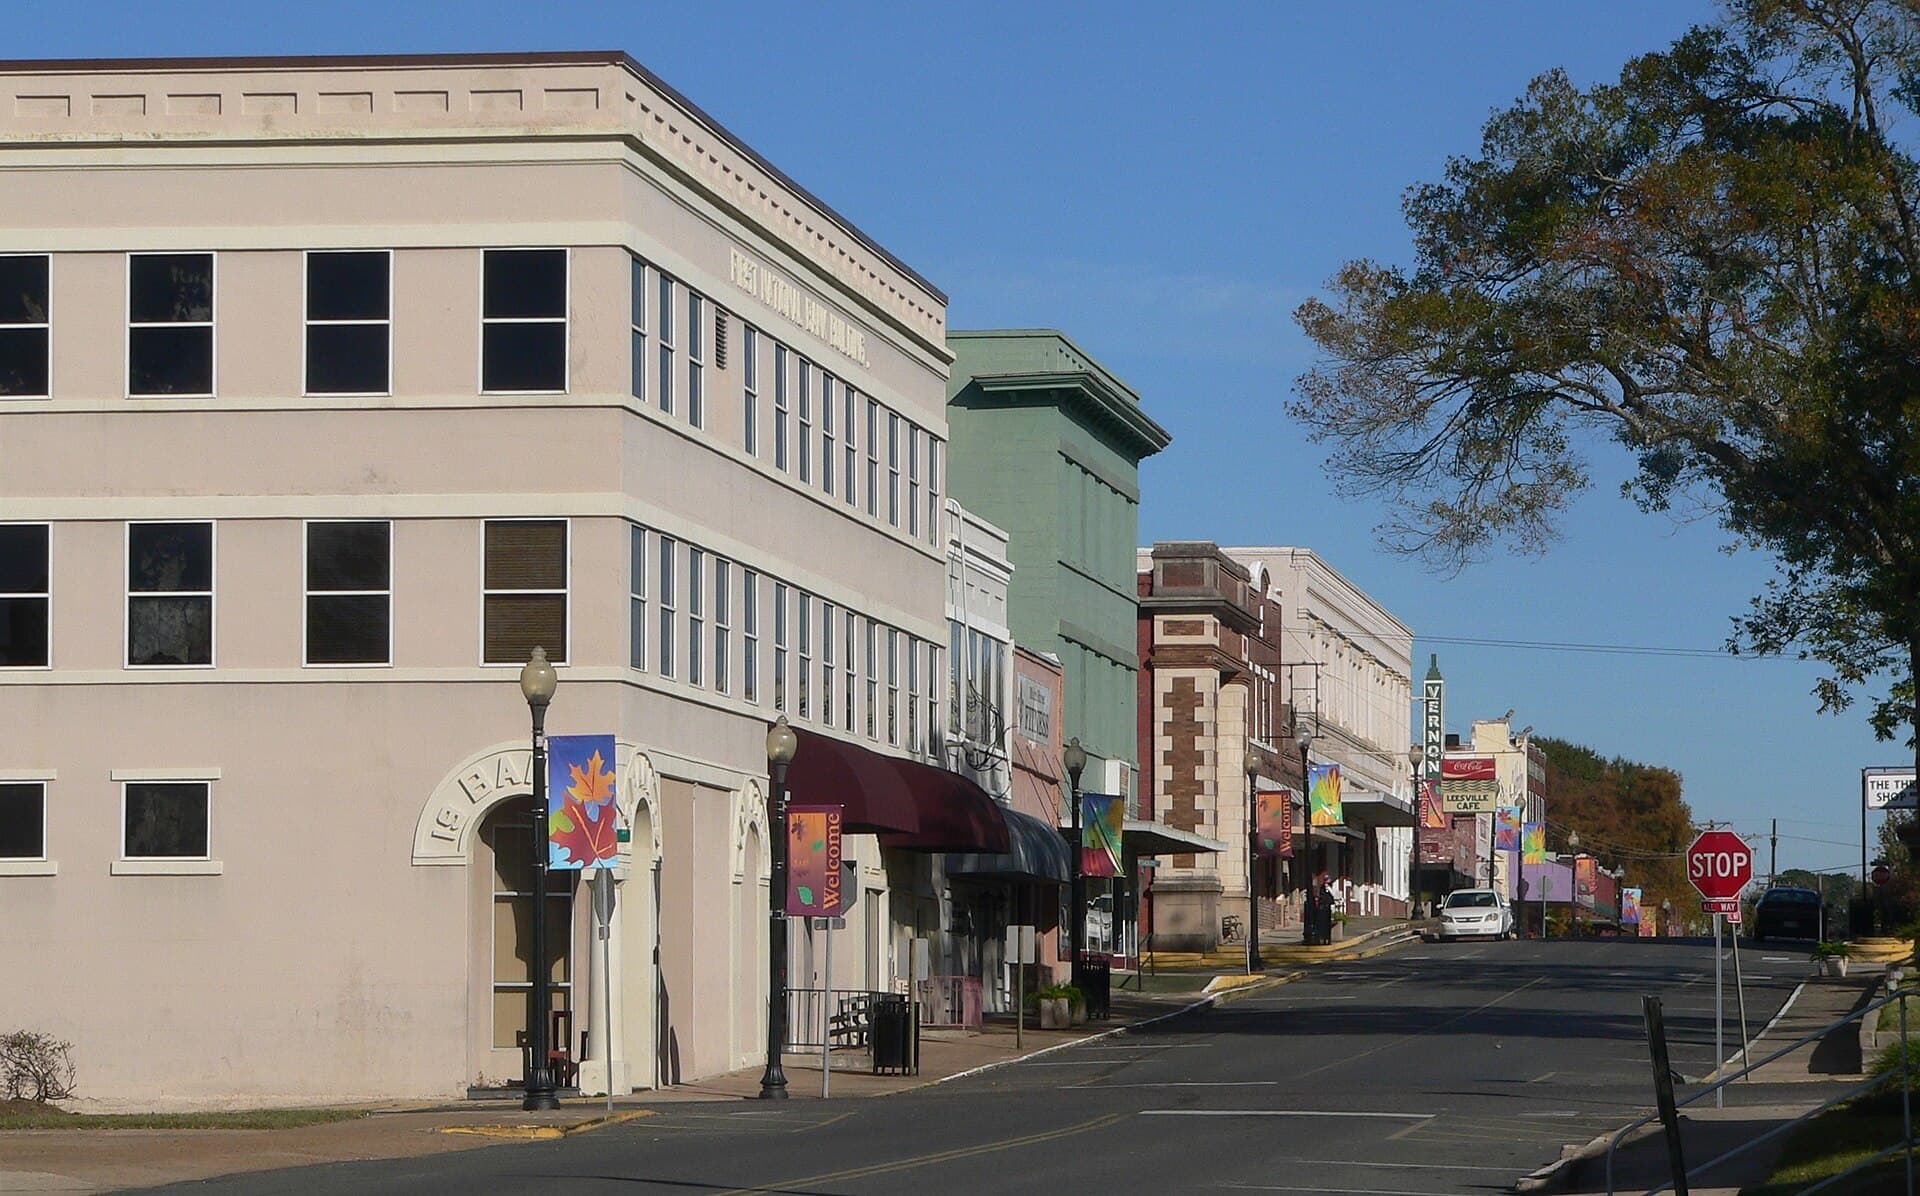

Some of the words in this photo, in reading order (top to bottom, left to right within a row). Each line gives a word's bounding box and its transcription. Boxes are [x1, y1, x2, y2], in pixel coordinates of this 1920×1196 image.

[1427, 686, 1440, 773] VERNON
[1870, 780, 1889, 790] THE
[1894, 780, 1916, 790] THR
[1446, 794, 1489, 802] LEESVILLE
[1876, 792, 1905, 801] SHOP
[1456, 802, 1480, 810] CAFE
[1280, 794, 1291, 852] Welcome
[823, 812, 840, 910] Welcome
[1692, 852, 1747, 877] STOP
[1720, 903, 1736, 911] WAY
